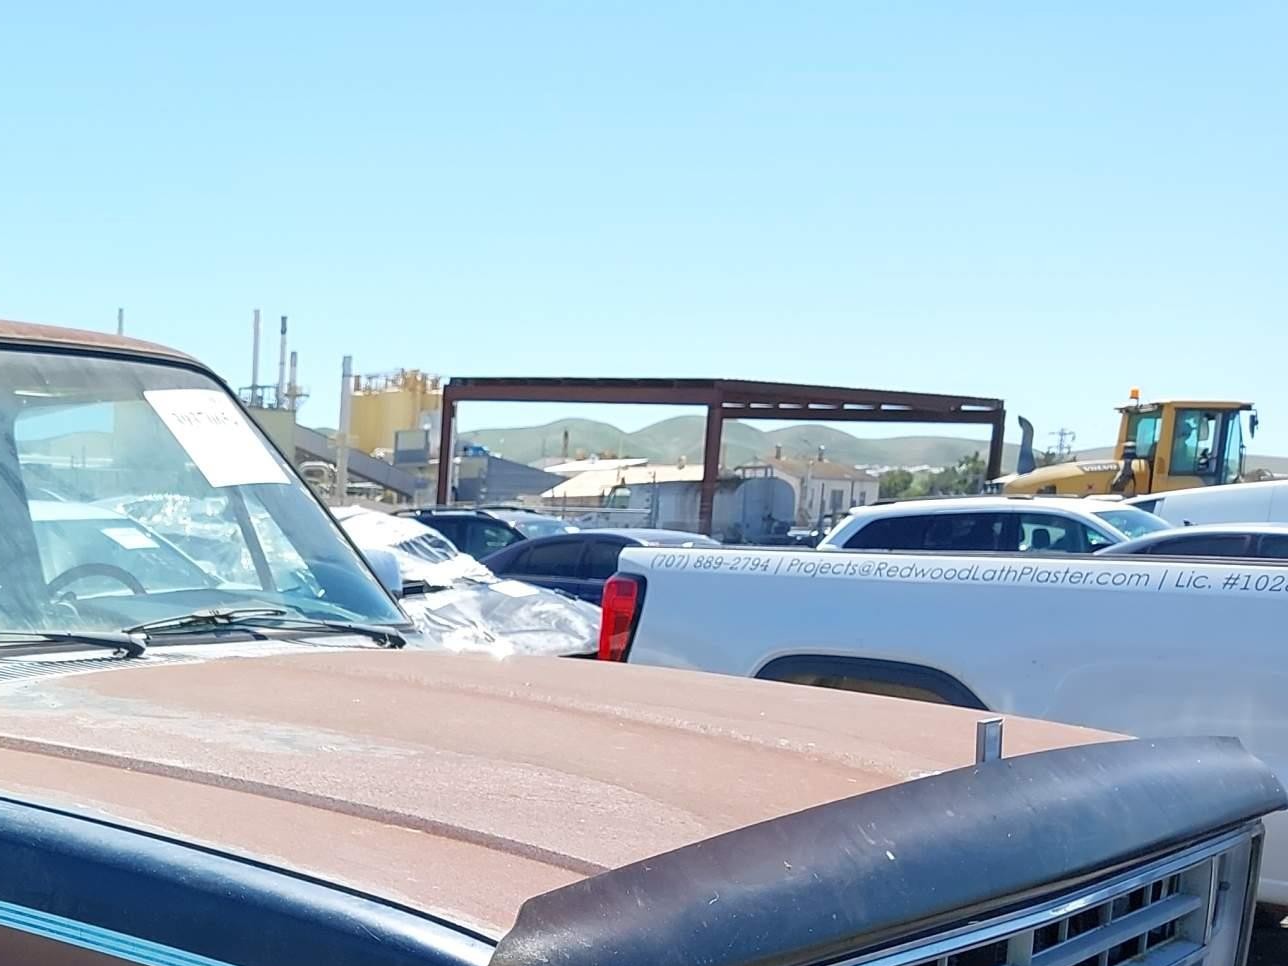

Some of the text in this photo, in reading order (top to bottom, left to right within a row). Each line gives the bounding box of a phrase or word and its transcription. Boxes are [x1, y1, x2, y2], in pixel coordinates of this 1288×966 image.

[650, 554, 691, 569] (707)
[693, 556, 770, 572] 889-2794
[786, 558, 1151, 587] Projects@RedwoodLathPlaster.com
[1175, 570, 1212, 589] Lic.
[1222, 573, 1288, 592] #102
